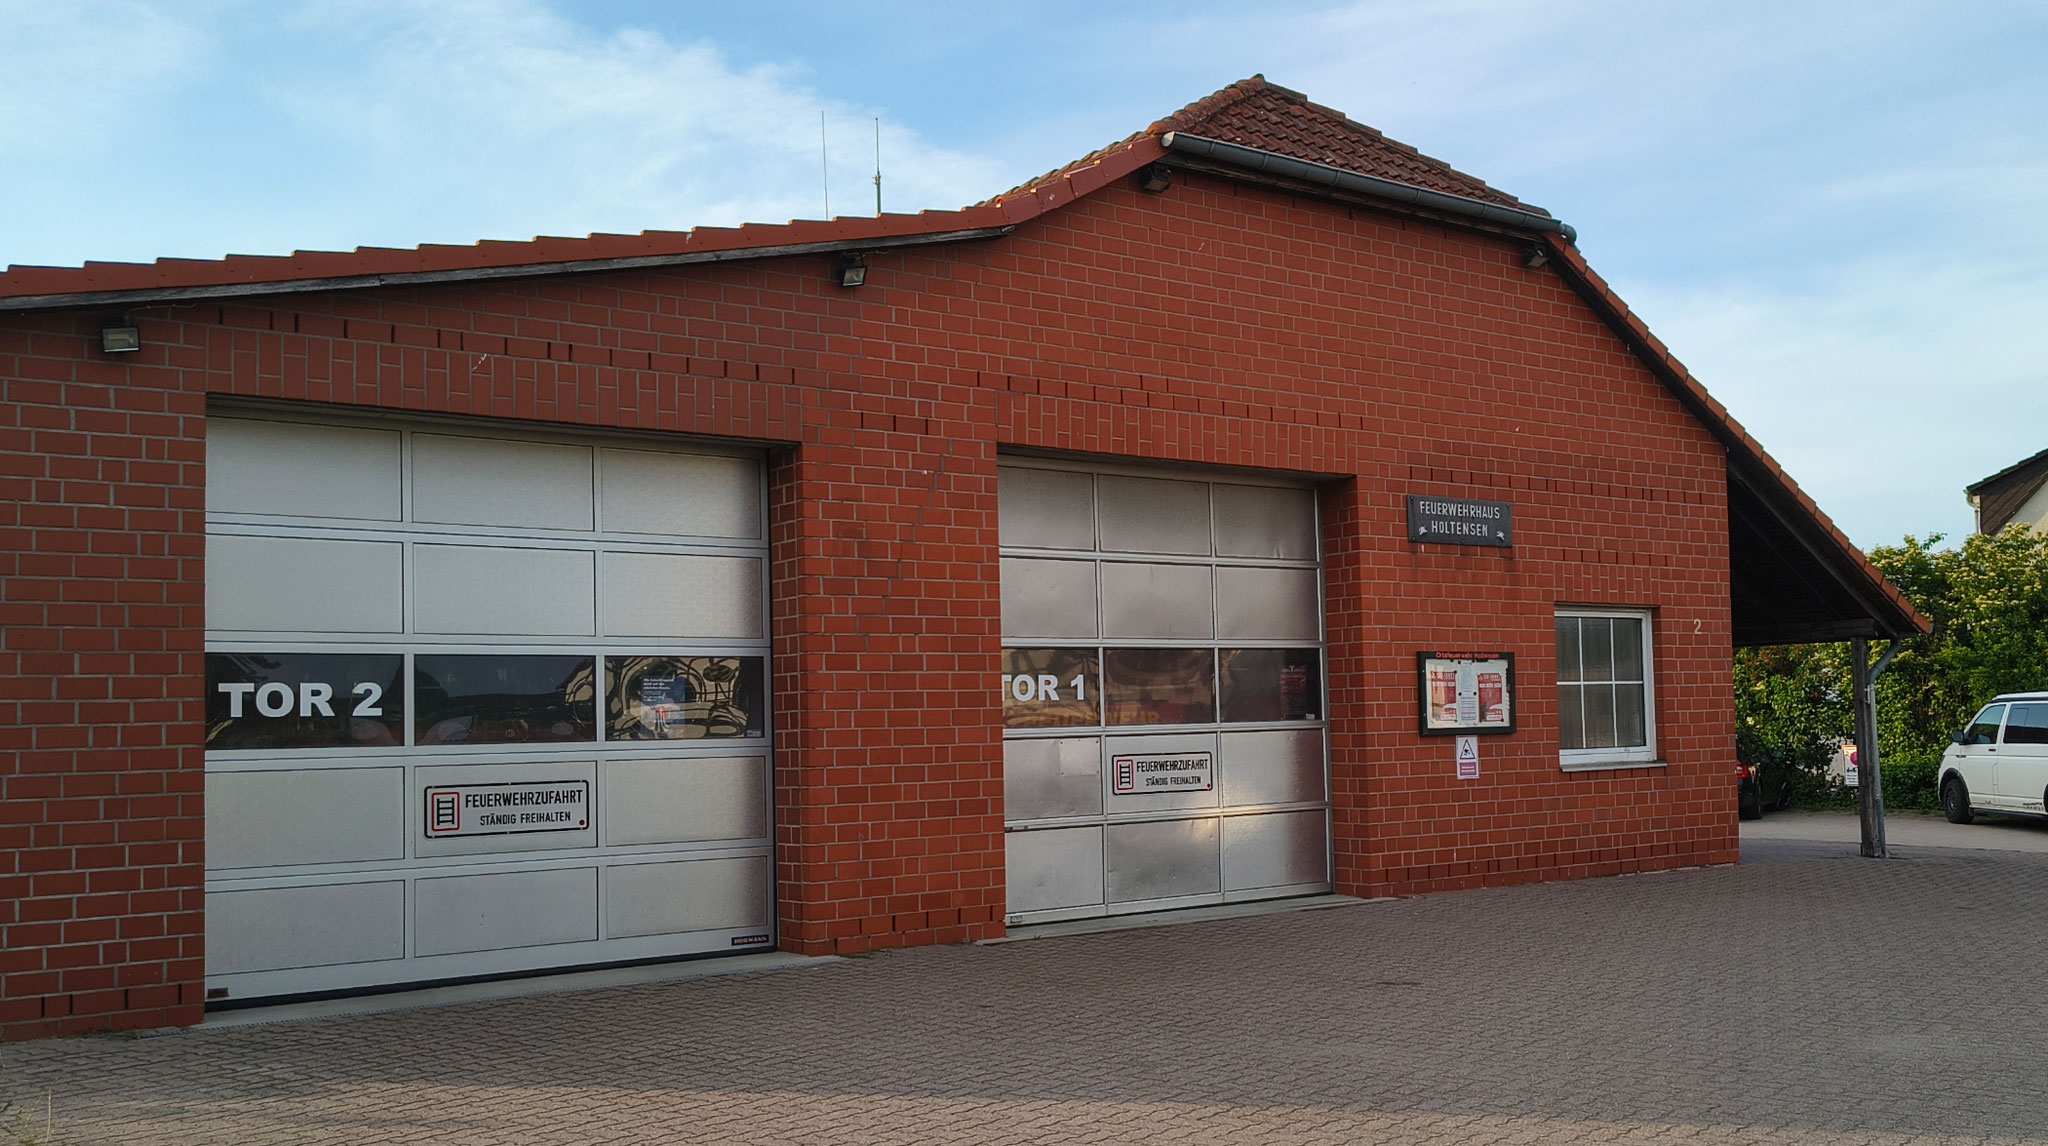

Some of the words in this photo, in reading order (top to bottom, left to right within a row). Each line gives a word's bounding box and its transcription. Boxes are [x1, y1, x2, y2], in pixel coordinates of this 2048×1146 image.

[1419, 501, 1500, 519] FEUERWEHRHAUS
[1431, 520, 1488, 537] HOLTENSEN
[1693, 618, 1702, 635] 2
[1070, 674, 1084, 700] 1
[217, 682, 336, 718] TOR
[351, 682, 383, 717] 2
[1136, 759, 1209, 773] FEUERWEHRZUFAHRT
[1145, 776, 1168, 787] STÄNDIG
[1170, 775, 1202, 786] FREIHALTEN
[465, 789, 583, 808] FEUERWEHRZUFAHRT
[479, 813, 517, 826] STÄNDIG
[520, 811, 571, 824] FREIHALTEN
